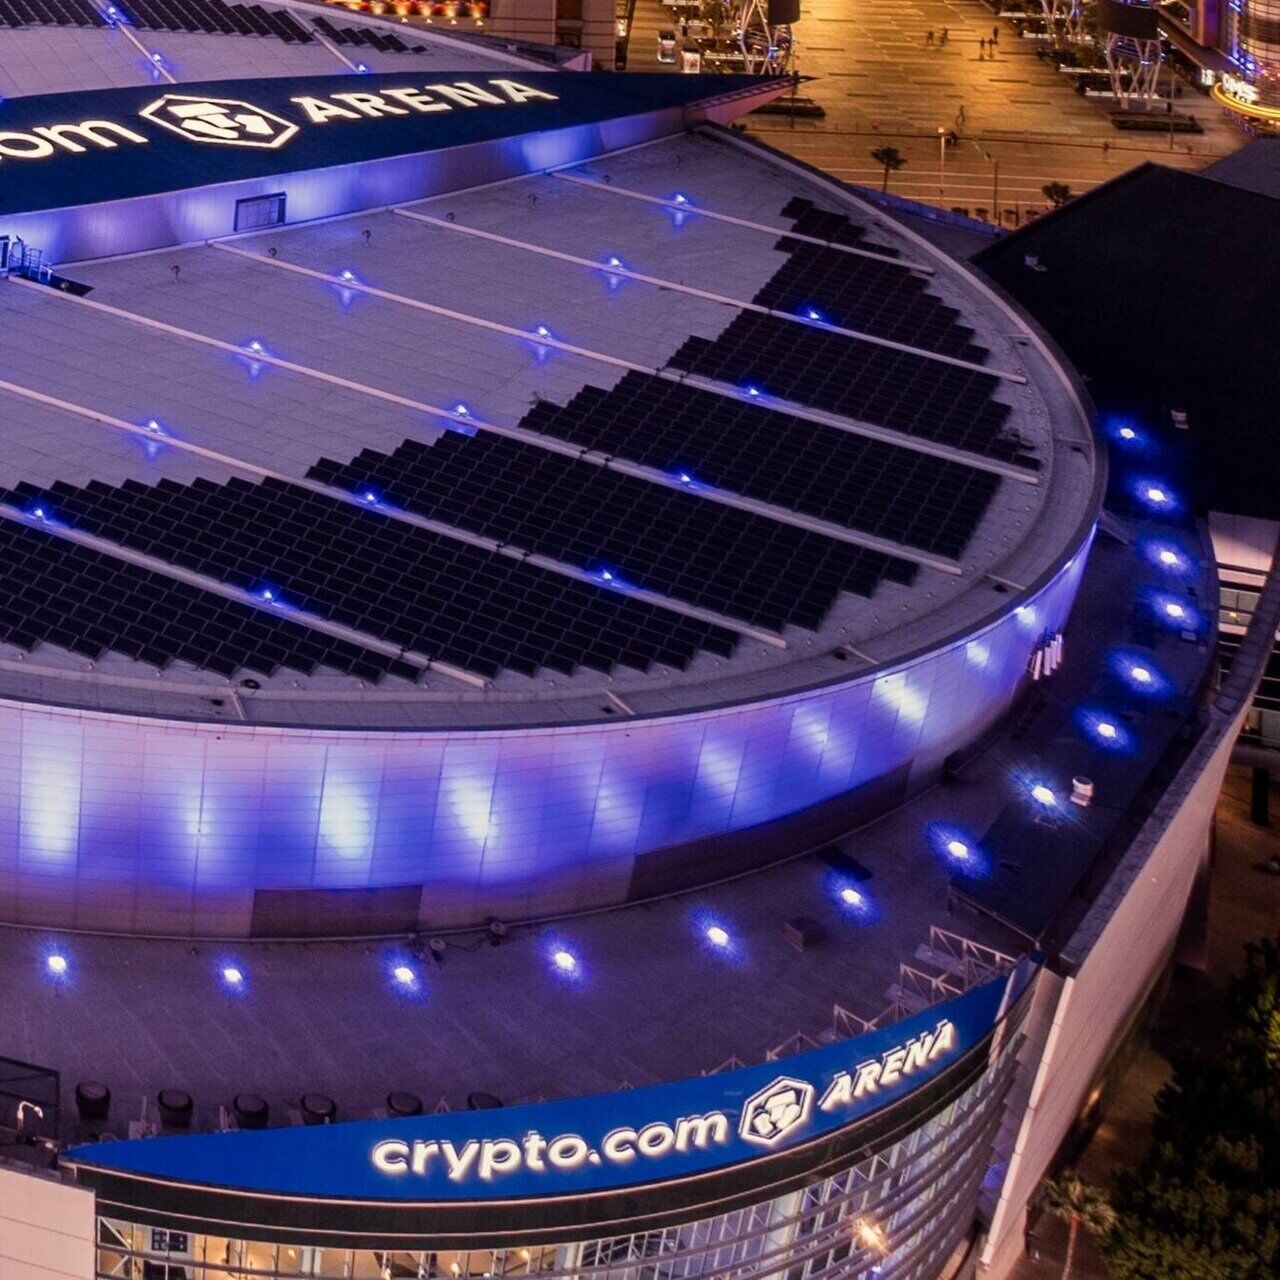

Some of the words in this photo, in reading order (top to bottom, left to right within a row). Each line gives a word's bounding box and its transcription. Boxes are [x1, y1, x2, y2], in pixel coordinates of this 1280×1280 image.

[287, 78, 560, 137] ARENA
[371, 1108, 729, 1182] crypto.com
[815, 1018, 956, 1112] ARENA
